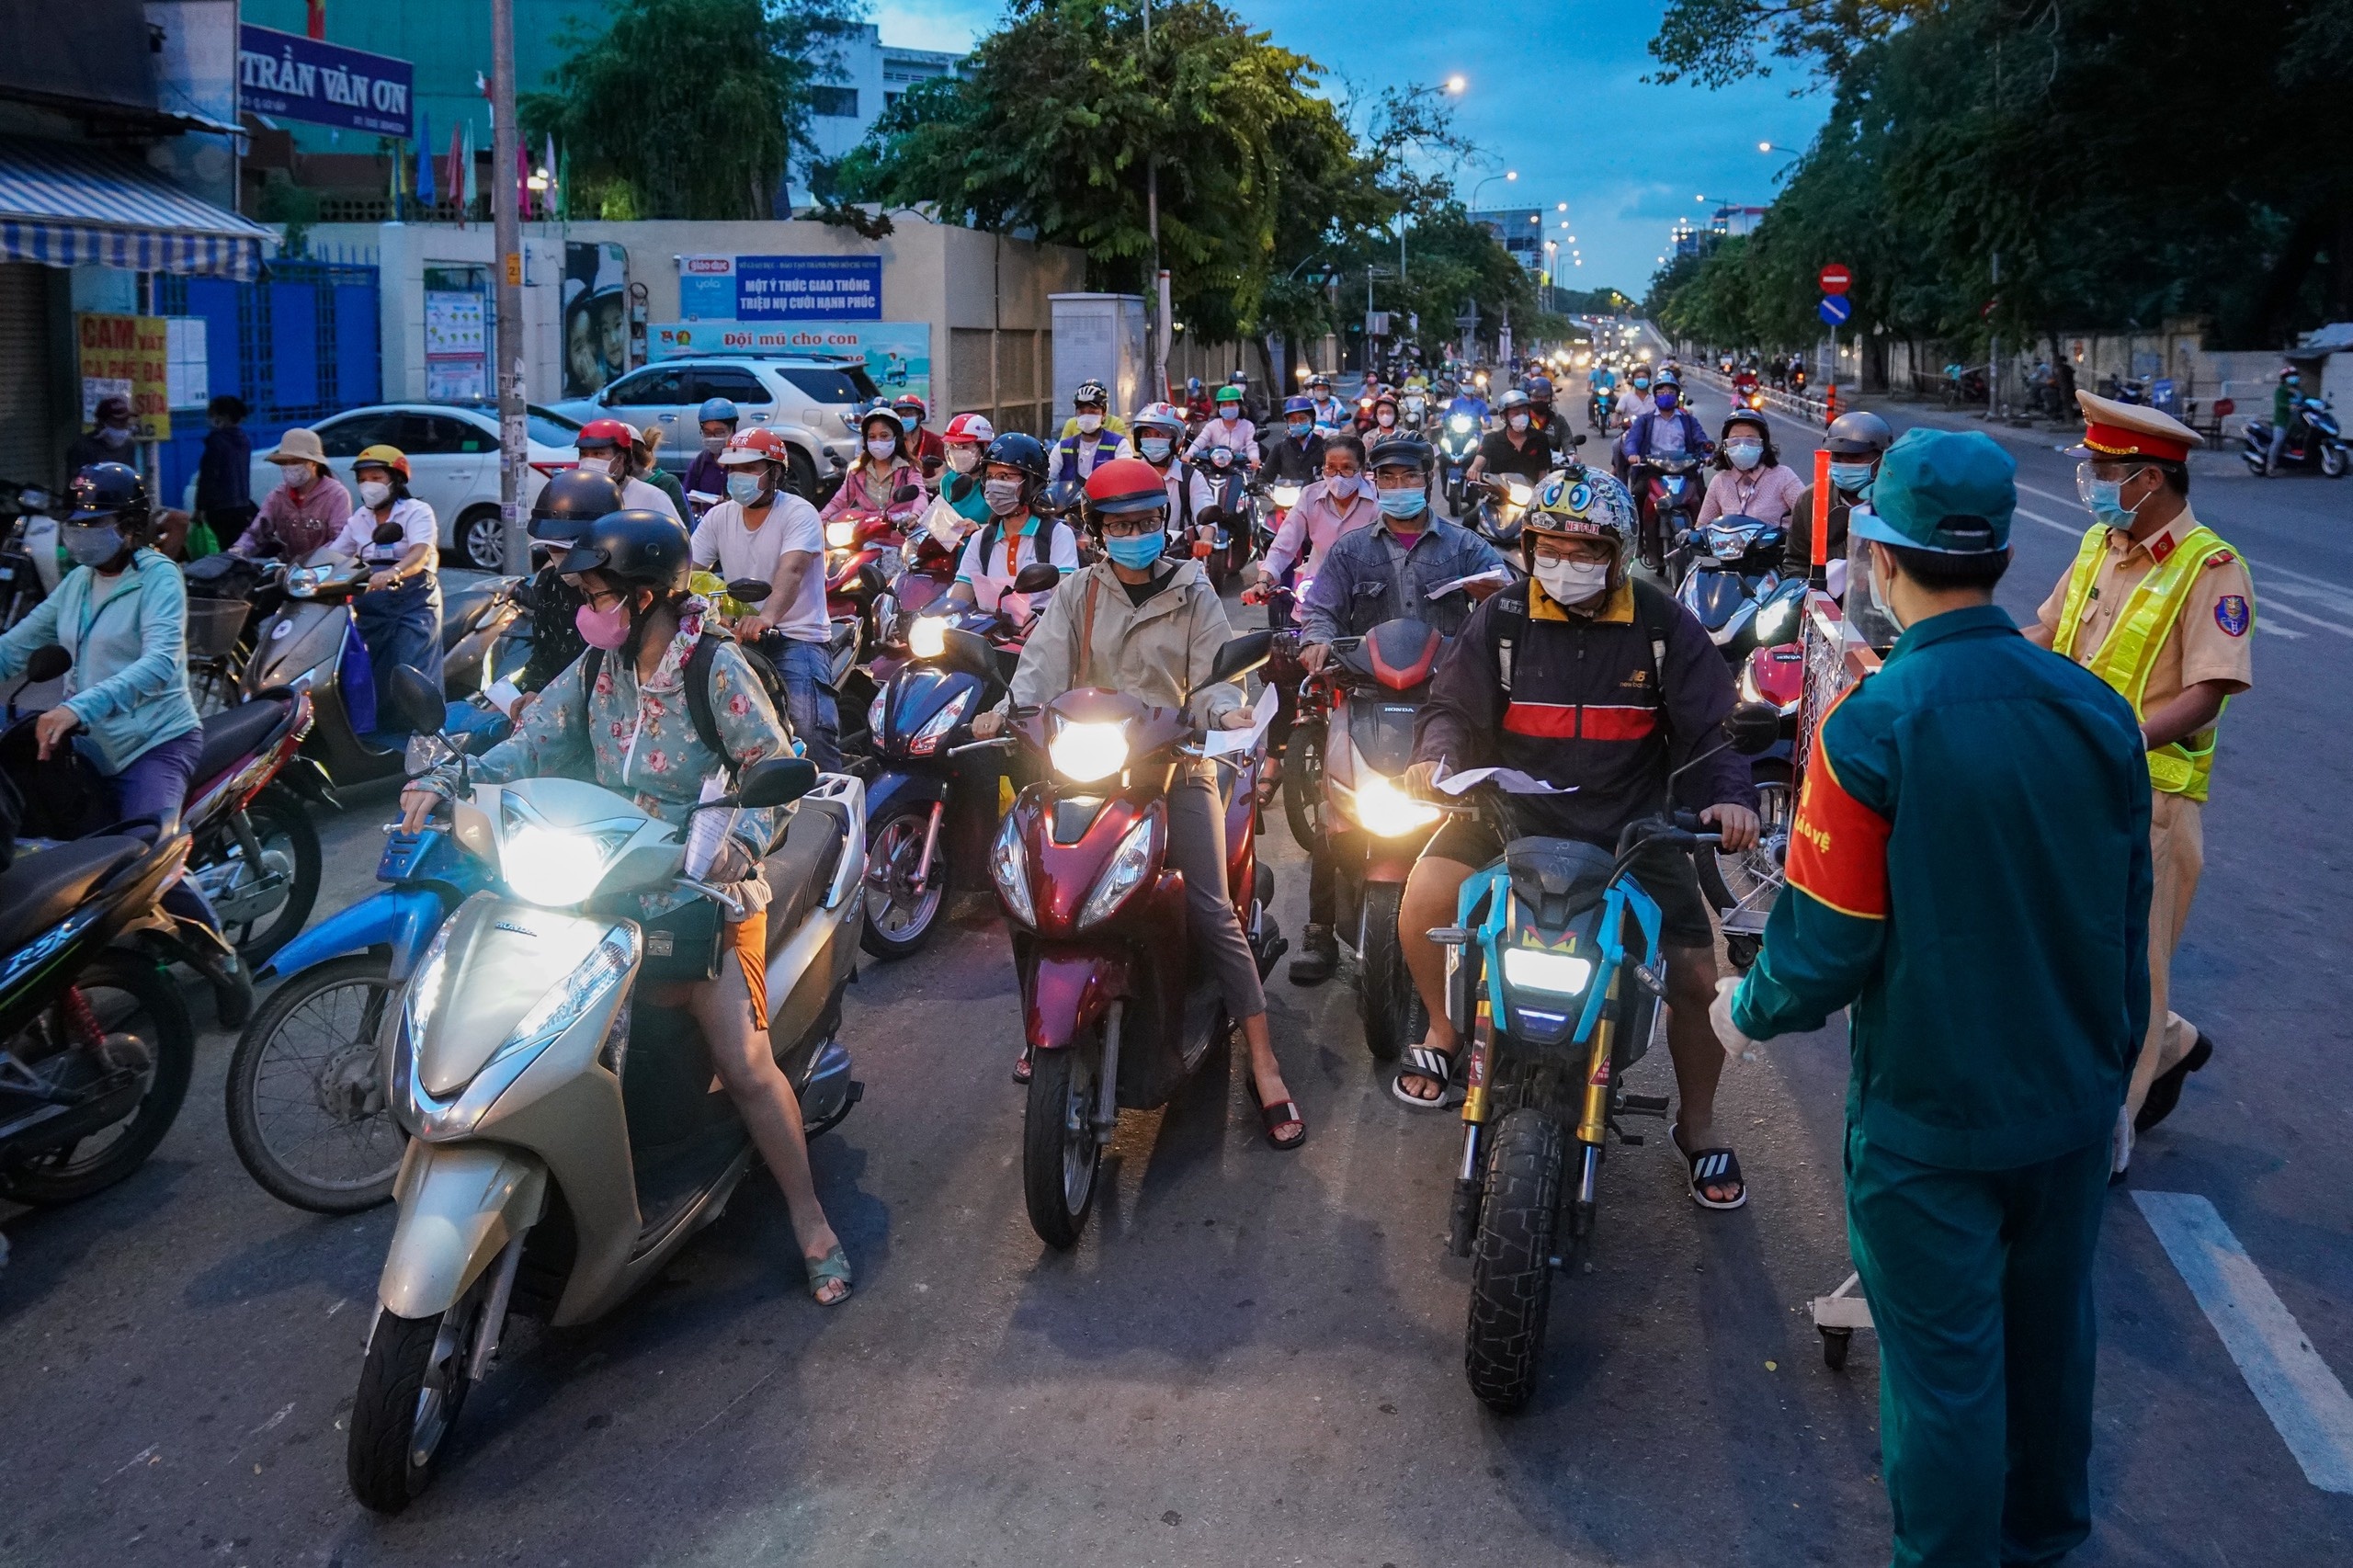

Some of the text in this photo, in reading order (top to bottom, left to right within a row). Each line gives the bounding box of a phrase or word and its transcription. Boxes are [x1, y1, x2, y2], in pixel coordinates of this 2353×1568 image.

[240, 45, 317, 97] TRẦN
[319, 64, 369, 108] VĂN
[372, 79, 407, 114] ƠN
[745, 278, 870, 294] MỘT Ý THỨC GIAO THÔNG
[740, 295, 770, 312] TRIỆU
[772, 298, 787, 312] NỤ
[817, 297, 846, 311] HẠNH
[847, 294, 876, 309] PHÚC
[82, 316, 135, 348] CAM
[723, 332, 858, 348] Đội mũ cho con
[1565, 521, 1599, 533] NETFLIX
